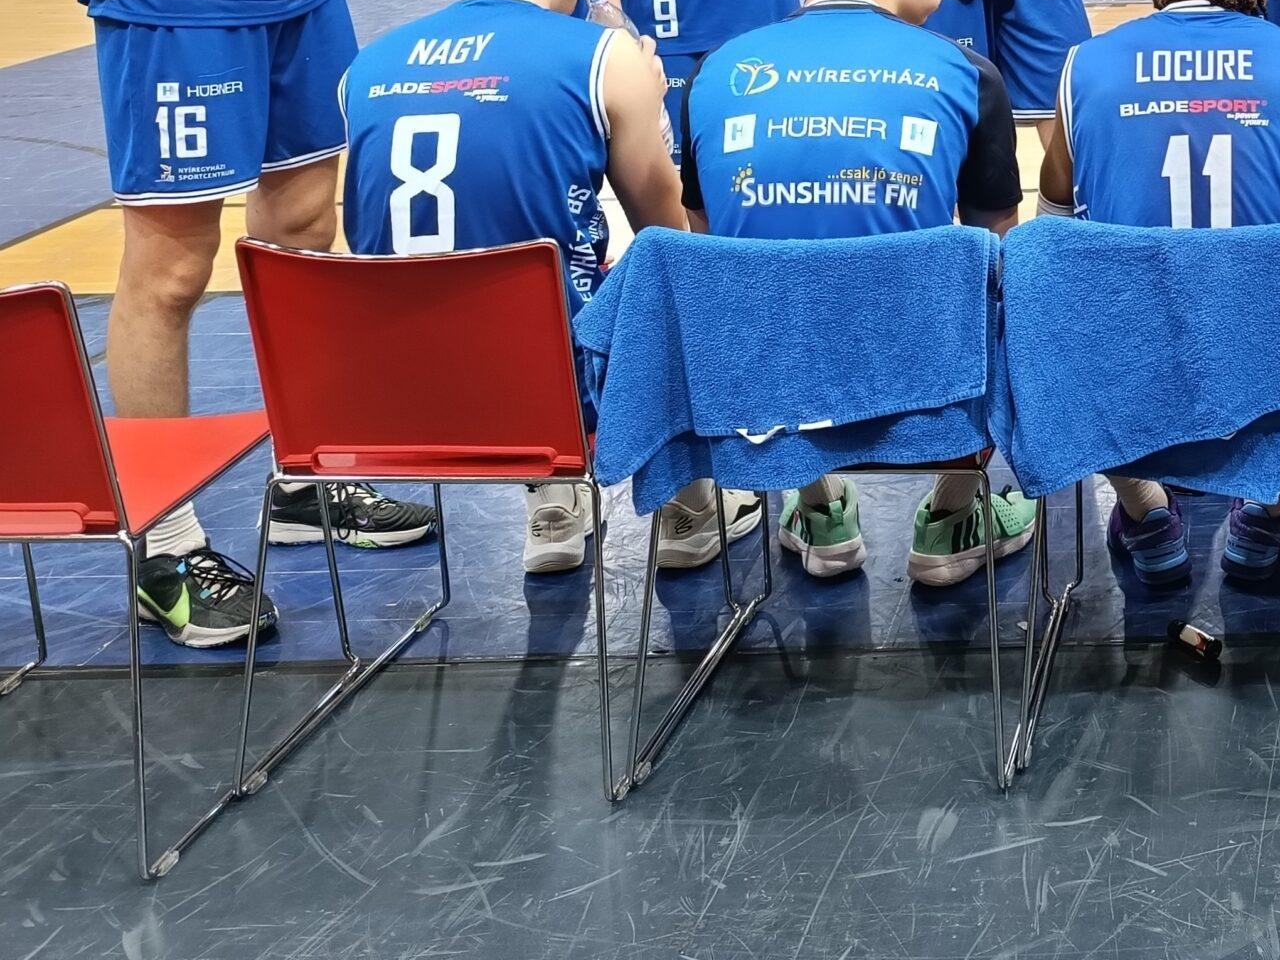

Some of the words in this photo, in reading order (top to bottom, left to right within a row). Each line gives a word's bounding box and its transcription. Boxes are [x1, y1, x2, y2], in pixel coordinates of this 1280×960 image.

[406, 32, 495, 66] NAGY
[786, 67, 940, 92] NYÍREGYHÁZA
[1135, 49, 1254, 83] LOCURE
[155, 105, 207, 159] 16
[767, 116, 888, 140] HÜBNER
[178, 169, 235, 181] SPORTCENTRUM
[390, 113, 461, 255] 8
[872, 167, 885, 182] jó
[889, 170, 923, 186] zene!
[1160, 134, 1233, 229] 11
[567, 184, 592, 215] BS
[741, 177, 877, 208] SUNSHINE
[884, 184, 918, 209] FM
